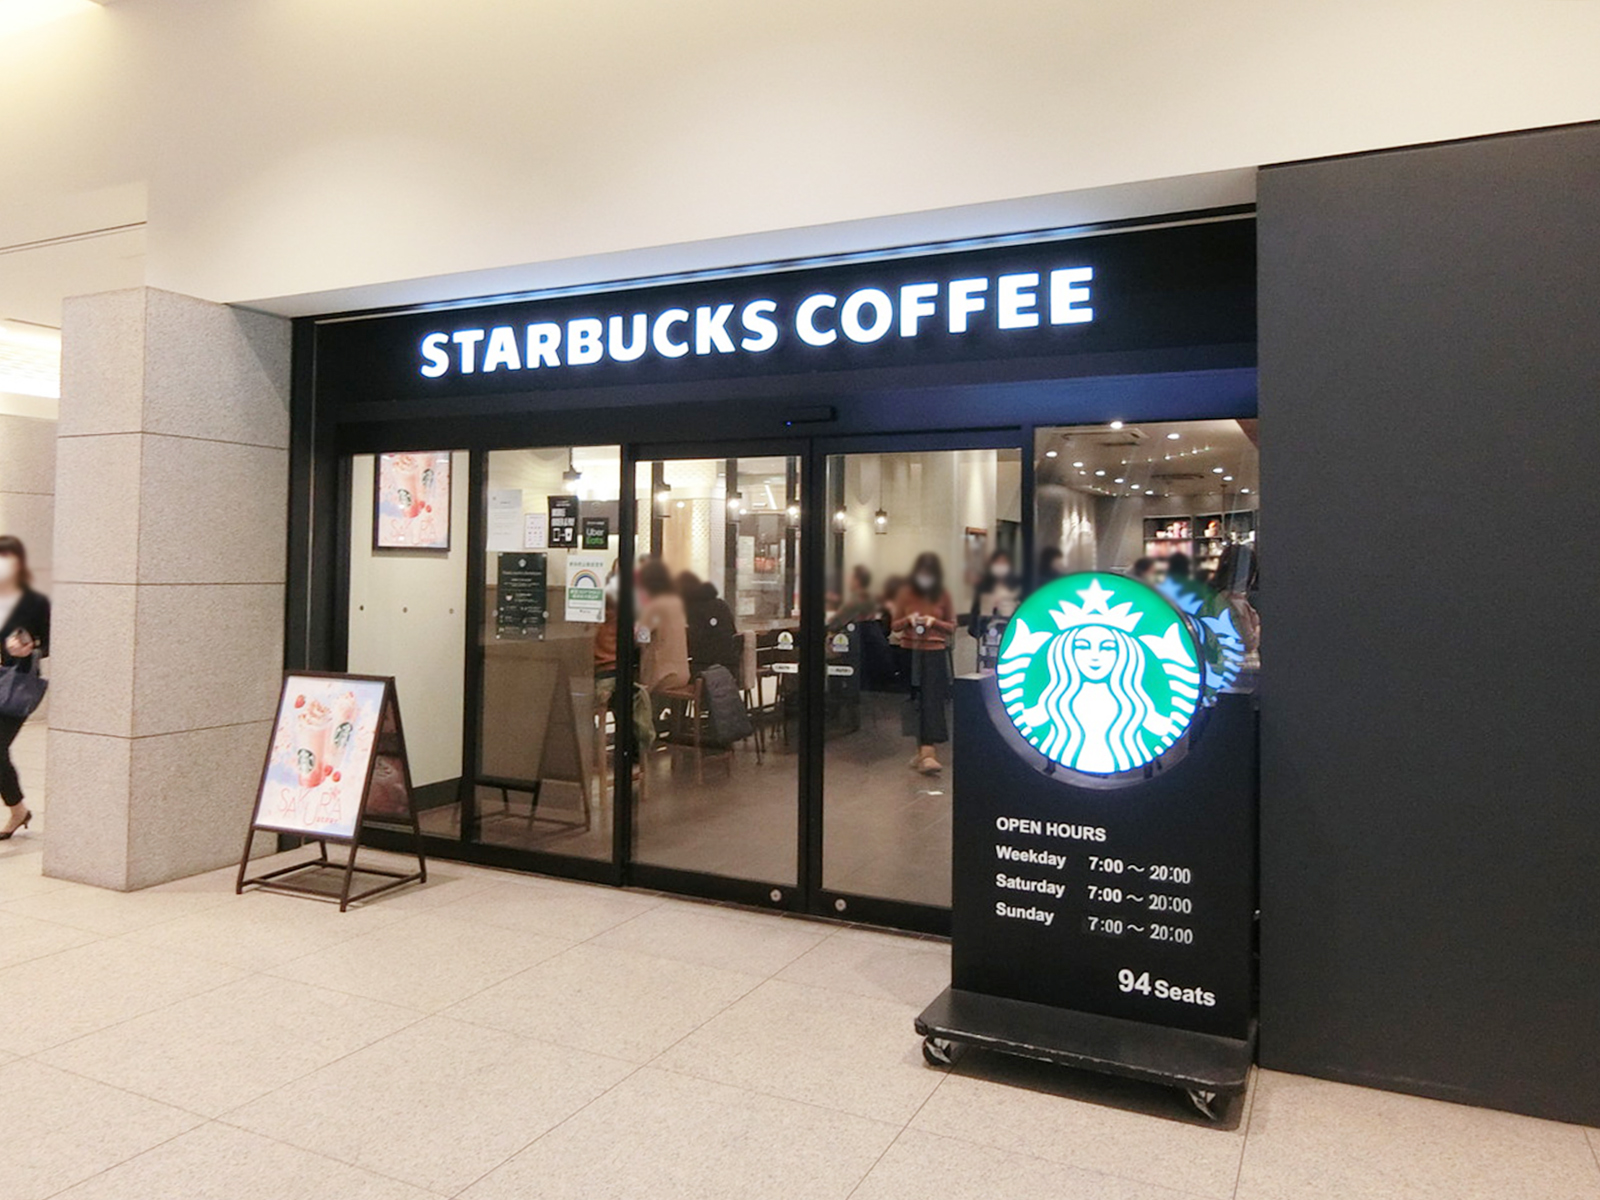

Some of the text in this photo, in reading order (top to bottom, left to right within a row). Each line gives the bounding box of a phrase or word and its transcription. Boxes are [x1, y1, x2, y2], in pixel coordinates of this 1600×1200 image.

[420, 266, 1094, 379] STARBUCKS COFFEE
[586, 528, 604, 536] Uber
[995, 816, 1107, 842] OPEN HOURS
[995, 844, 1067, 870] Weekday
[1088, 856, 1124, 874] 7:00
[1149, 864, 1192, 885] 20:00
[995, 873, 1066, 899] Saturday
[1087, 885, 1123, 903] 7:00
[1148, 894, 1193, 914] 20:00
[995, 901, 1055, 926] Sunday
[1087, 916, 1123, 935] 7:00
[1149, 923, 1194, 945] 20:00
[1117, 968, 1216, 1007] 94 Seats
